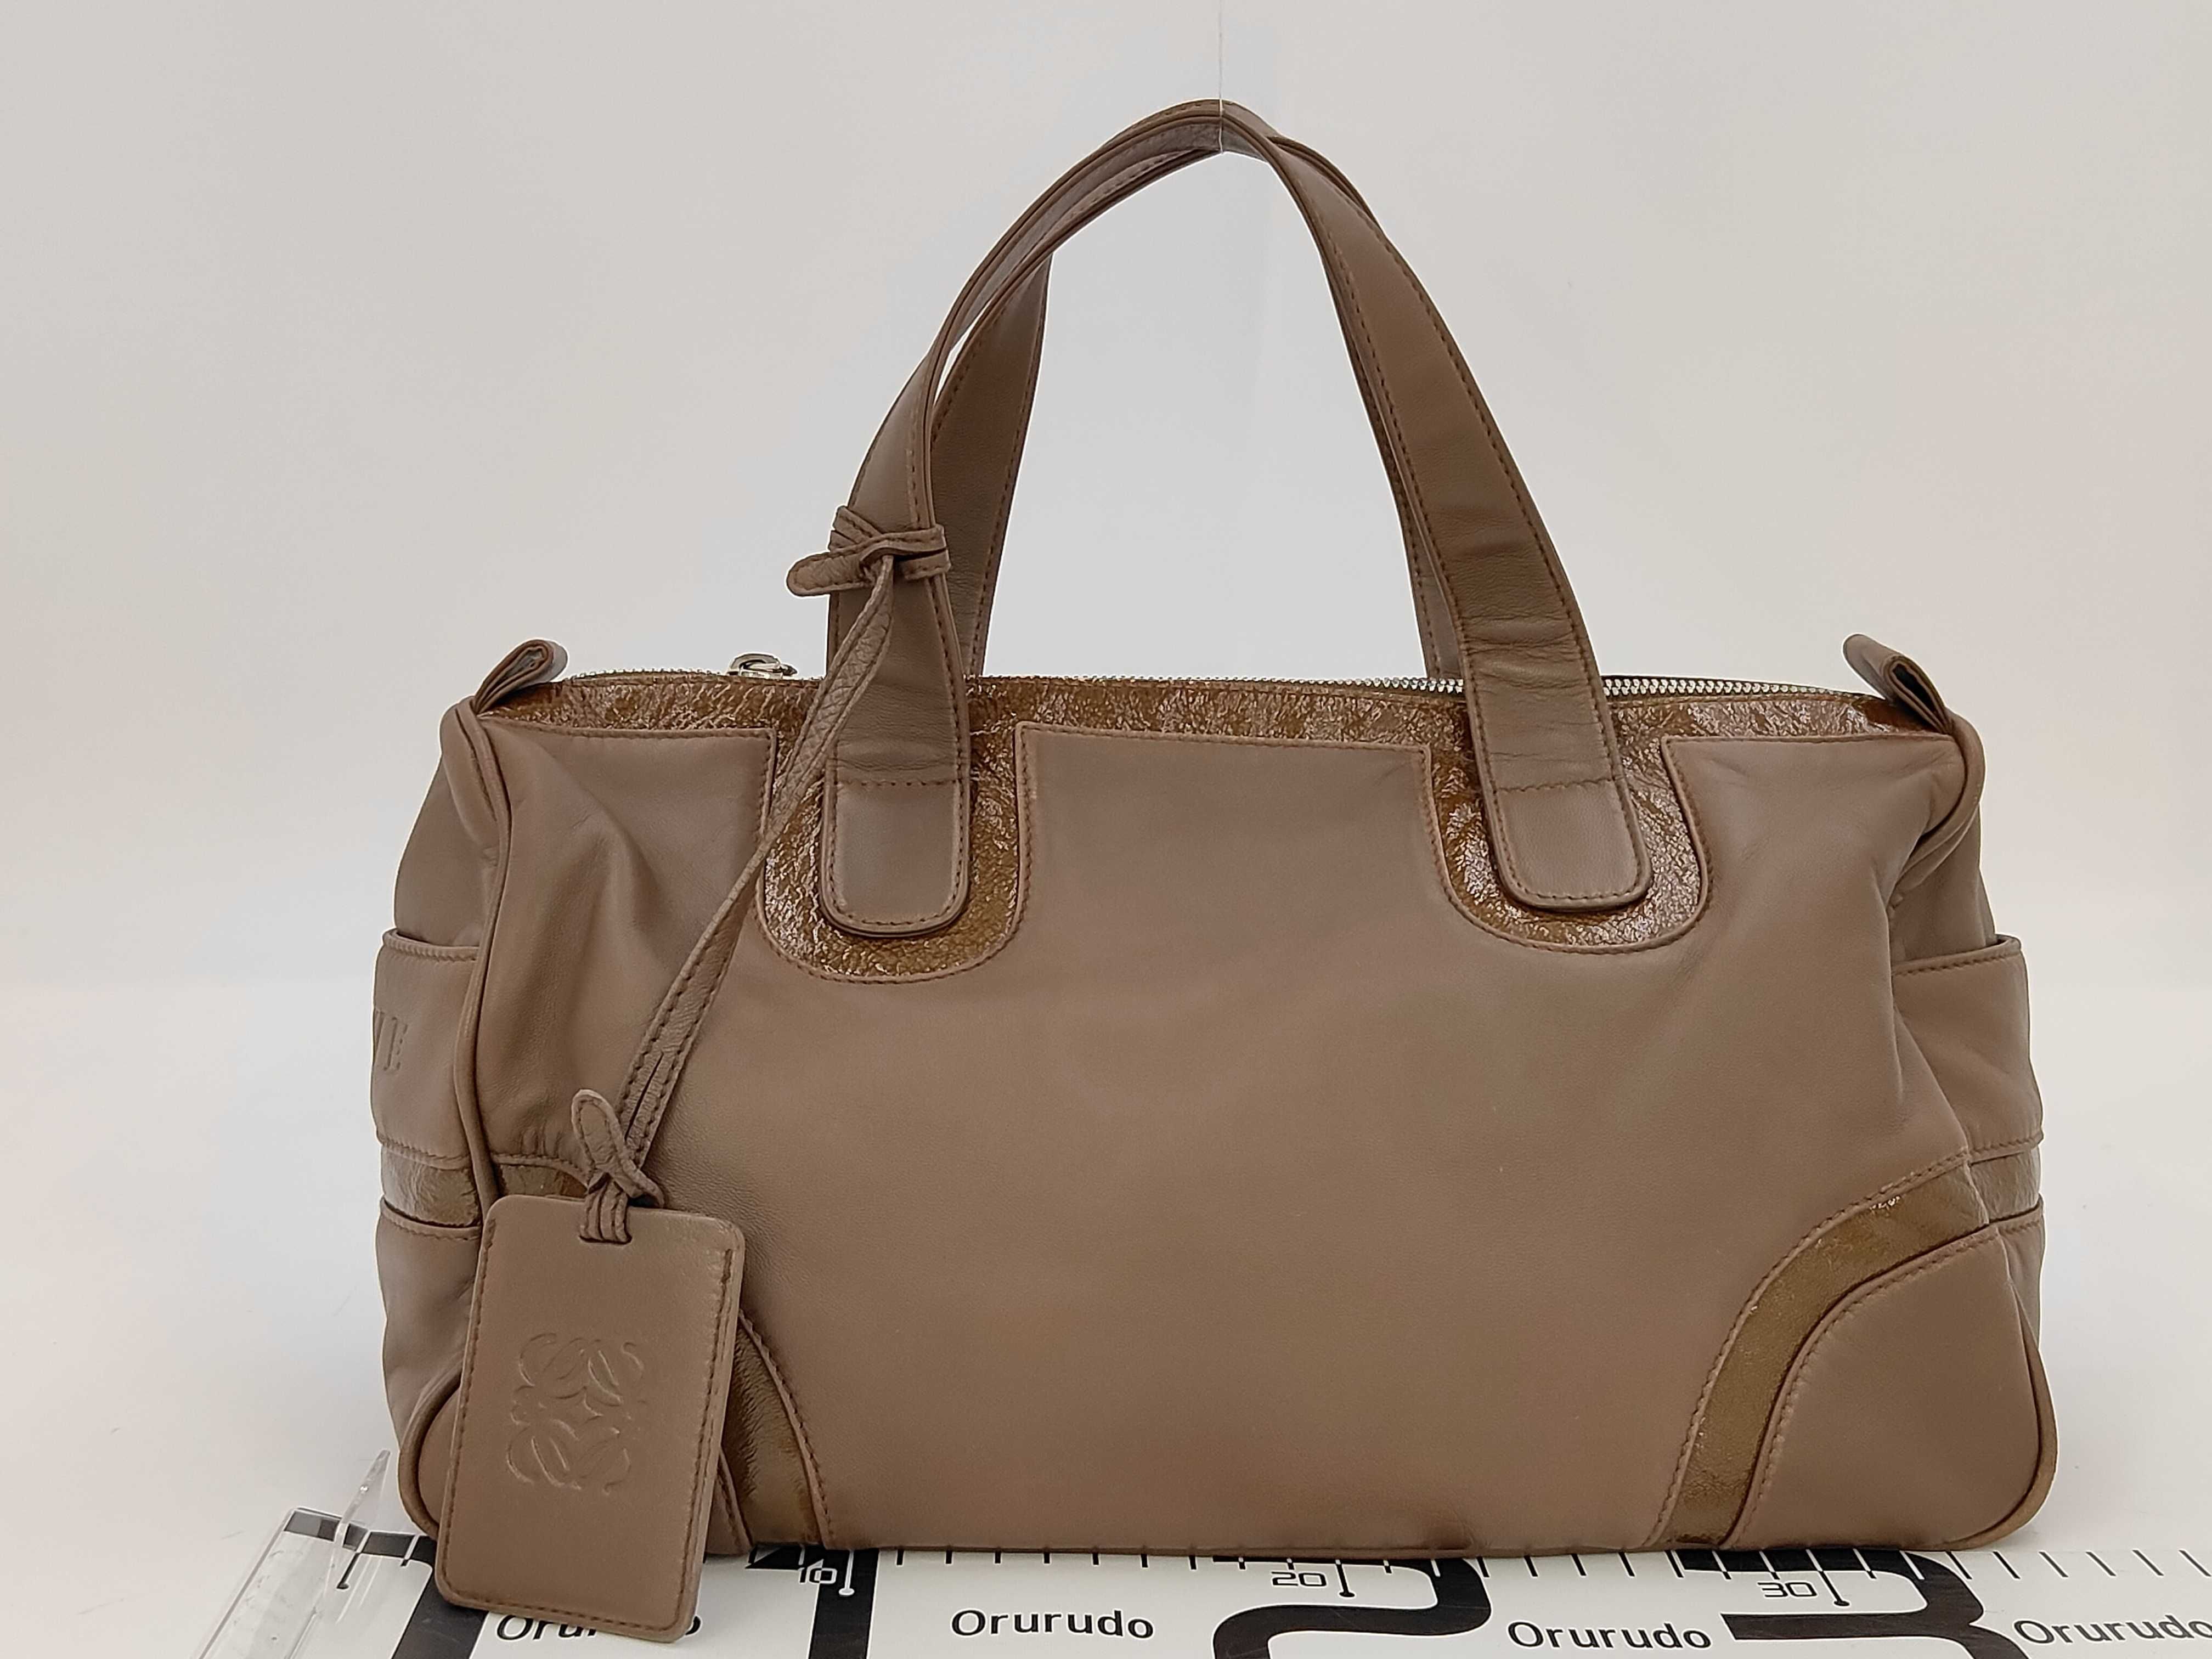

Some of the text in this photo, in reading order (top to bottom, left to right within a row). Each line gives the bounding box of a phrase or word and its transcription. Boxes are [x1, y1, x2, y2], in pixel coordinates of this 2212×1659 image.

[799, 1567, 838, 1584] 10
[1271, 1571, 1327, 1587] 20
[1757, 1581, 1818, 1598] 30
[952, 1610, 1153, 1639] Orurudo
[1508, 1622, 1711, 1649] Orurudo
[2014, 1615, 2212, 1644] Orurudo
